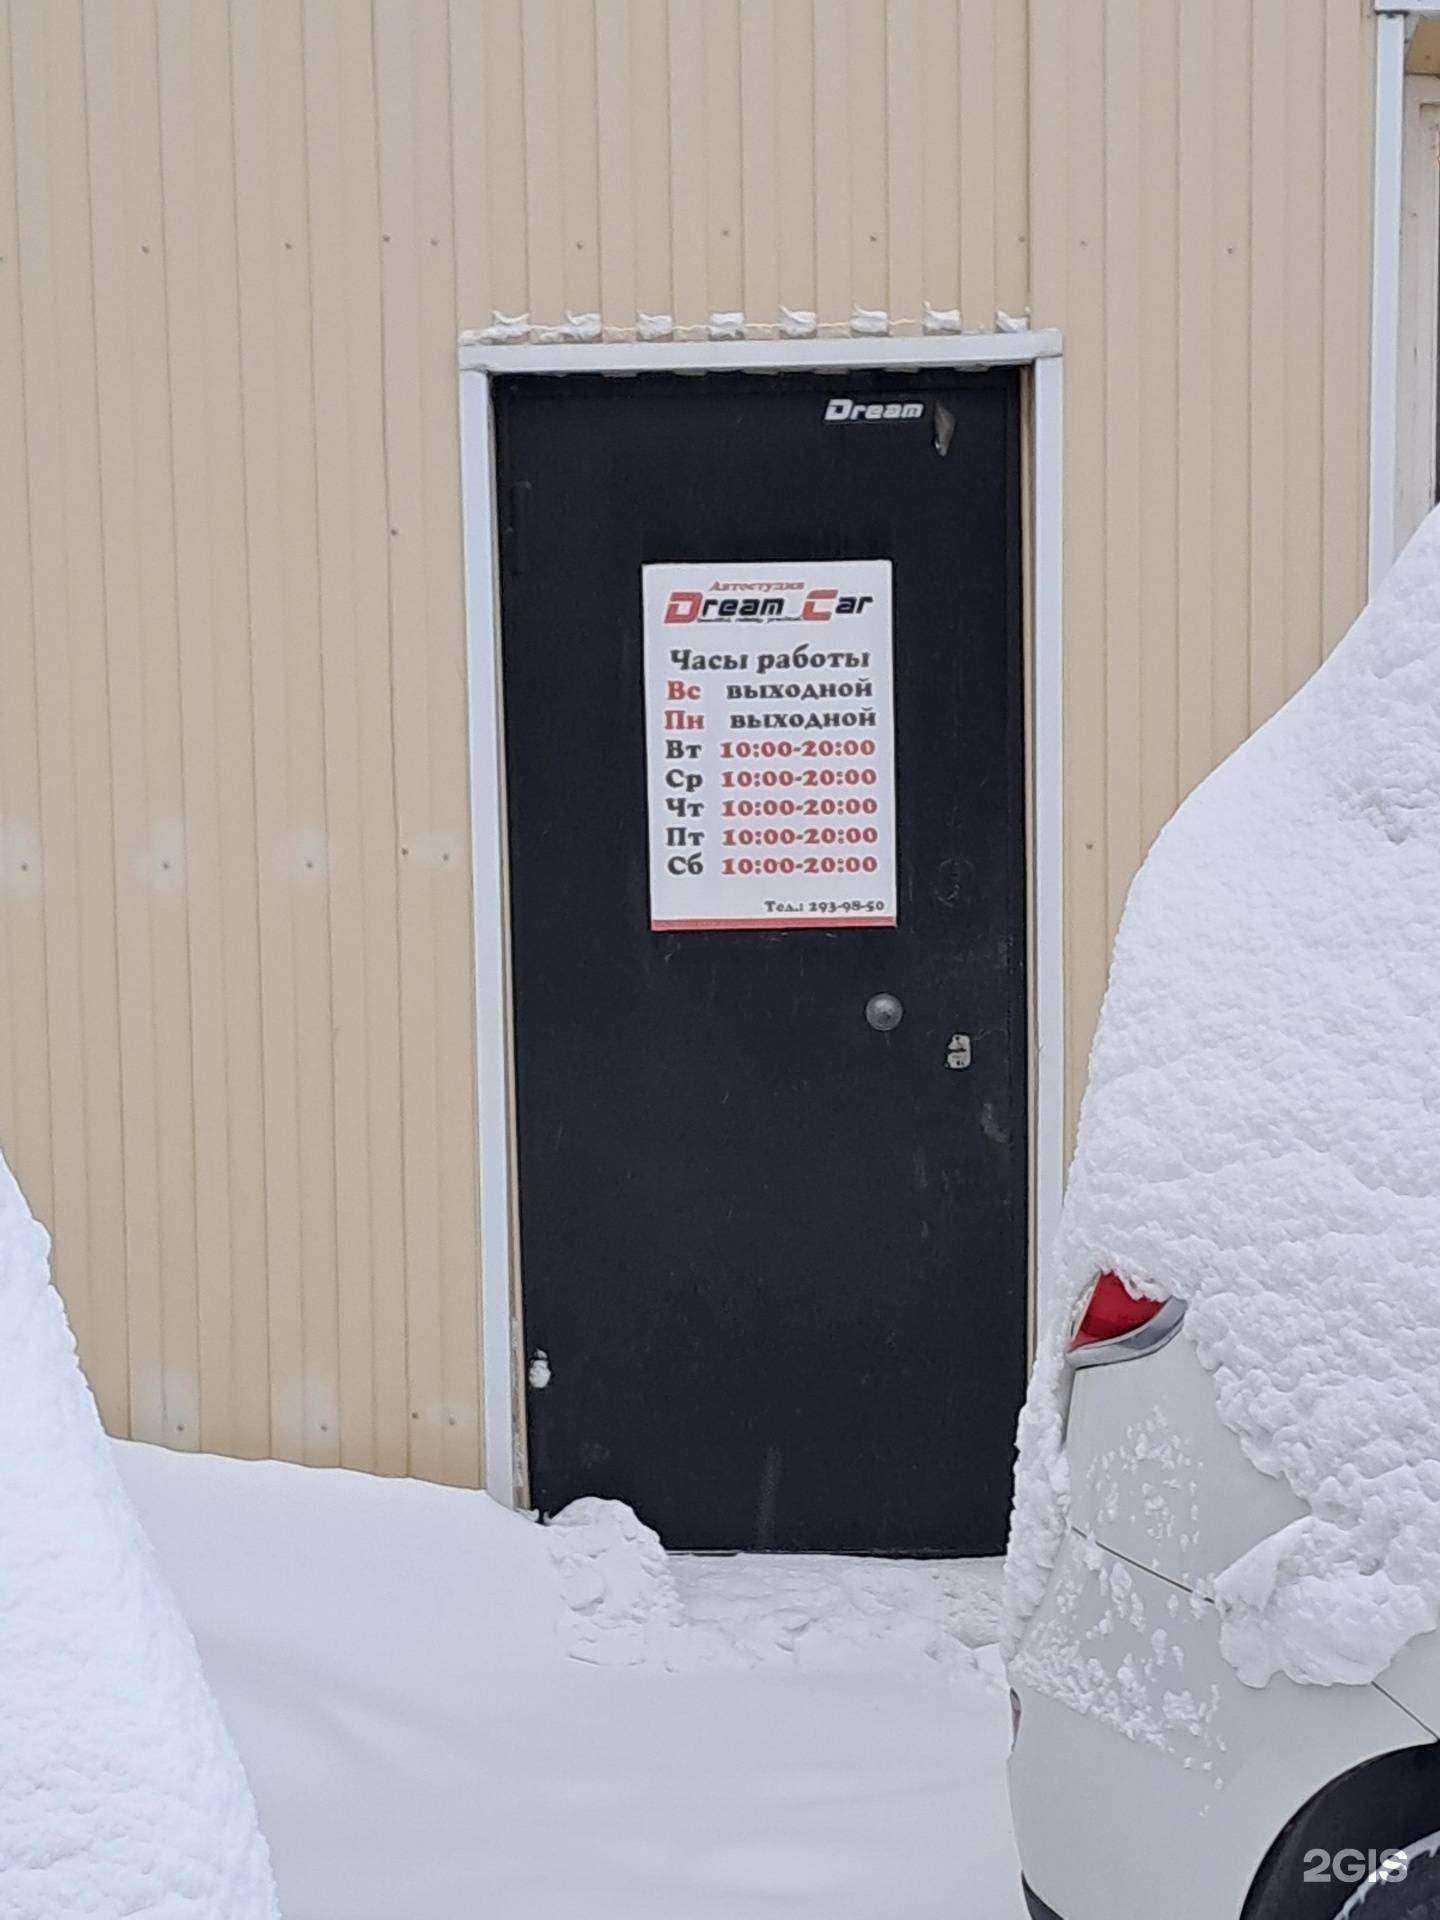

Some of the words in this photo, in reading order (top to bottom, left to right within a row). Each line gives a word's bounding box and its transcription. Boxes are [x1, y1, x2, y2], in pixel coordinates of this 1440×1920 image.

[825, 399, 924, 420] Dream
[708, 581, 804, 592] Автостудия
[664, 592, 784, 623] Dream
[802, 590, 873, 621] Car
[670, 650, 748, 670] Часы
[757, 644, 871, 674] работы
[668, 681, 701, 700] Вс
[727, 678, 873, 701] выходной
[665, 711, 704, 730] Пн
[730, 707, 877, 730] выходной
[665, 740, 702, 759] Вт
[720, 740, 876, 758] 10:00-20:00
[665, 769, 703, 792] Ср
[721, 769, 877, 787] 10:00-20:00
[665, 798, 705, 817] Чт
[721, 799, 878, 817] 10:00-20:00
[666, 828, 705, 846] Пт
[721, 827, 878, 846] 10:00-20:00
[668, 854, 704, 875] Сб
[721, 857, 878, 875] 10:00-20:00
[809, 901, 885, 912] 293-98-50
